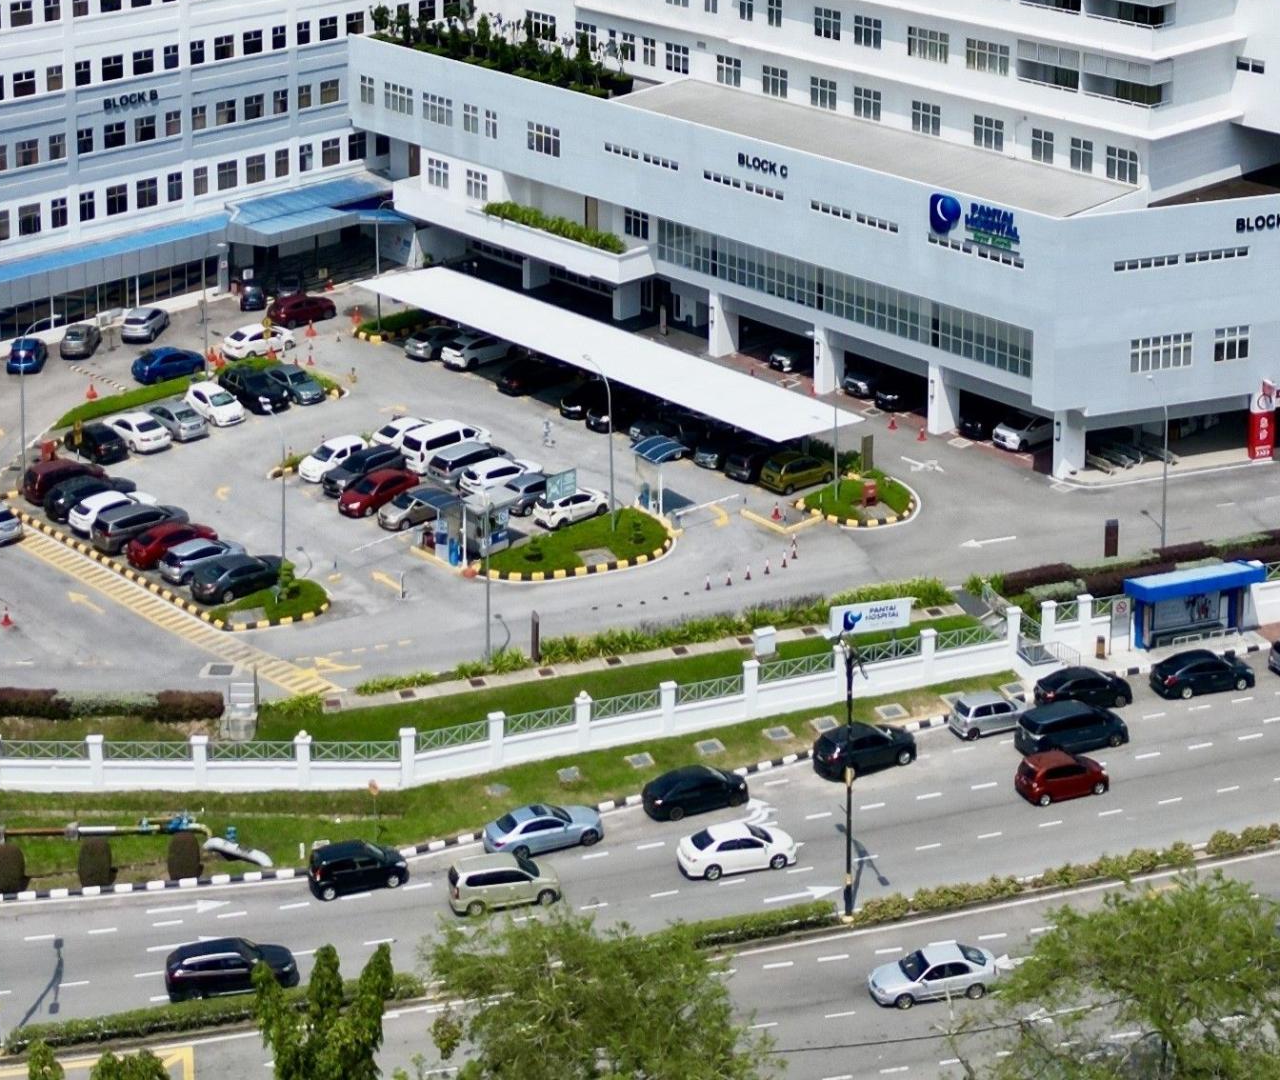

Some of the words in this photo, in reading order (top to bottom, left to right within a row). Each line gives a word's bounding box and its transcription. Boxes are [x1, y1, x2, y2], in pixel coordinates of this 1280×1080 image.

[103, 90, 146, 110] BLOCK
[149, 89, 158, 101] B
[737, 152, 778, 177] BLOCK
[779, 164, 788, 179] C
[970, 202, 1014, 225] PANTAI
[964, 214, 1020, 241] HOSPITAL
[869, 604, 897, 613] PANTAI
